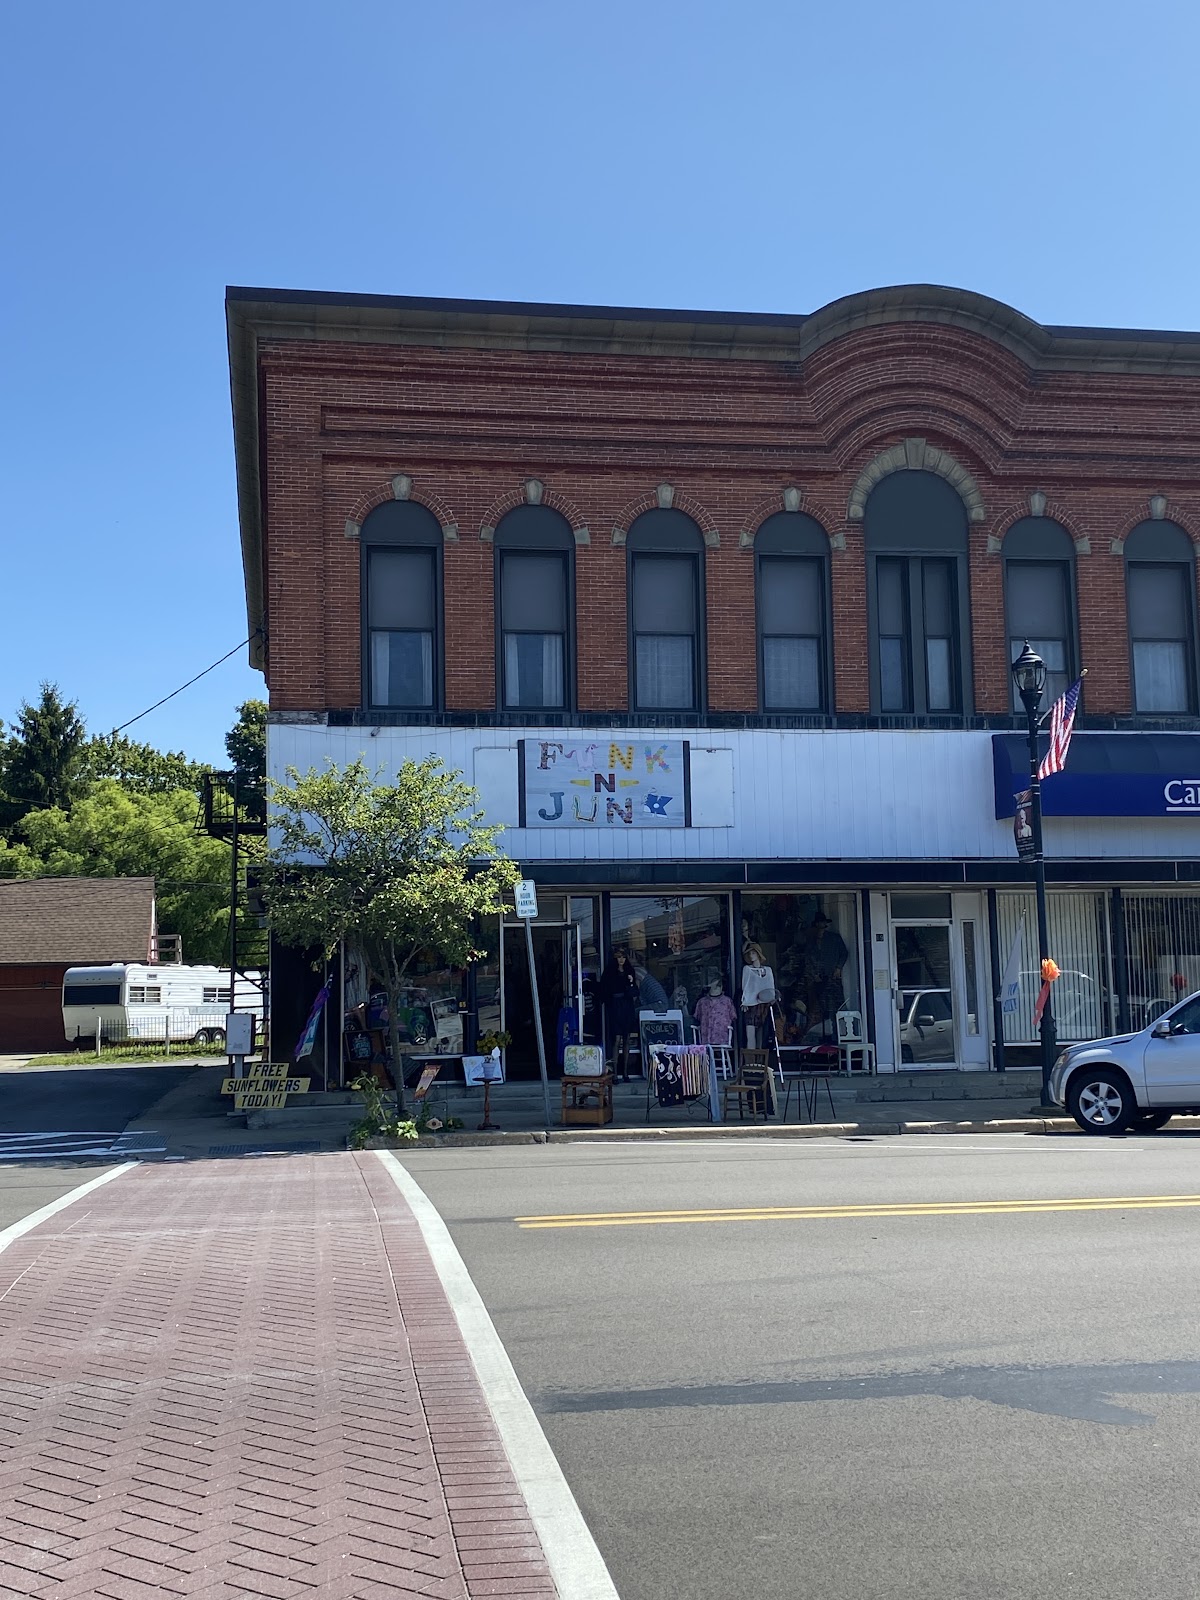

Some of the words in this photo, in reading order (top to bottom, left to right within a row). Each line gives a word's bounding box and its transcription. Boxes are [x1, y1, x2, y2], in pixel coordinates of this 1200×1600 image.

[537, 741, 672, 774] FUNK
[1164, 780, 1200, 804] Ca
[538, 788, 673, 824] JUNK
[522, 883, 527, 891] 2
[253, 1064, 285, 1077] FREE
[227, 1080, 301, 1093] SUNFLOWERS
[241, 1094, 282, 1107] TODAY!
